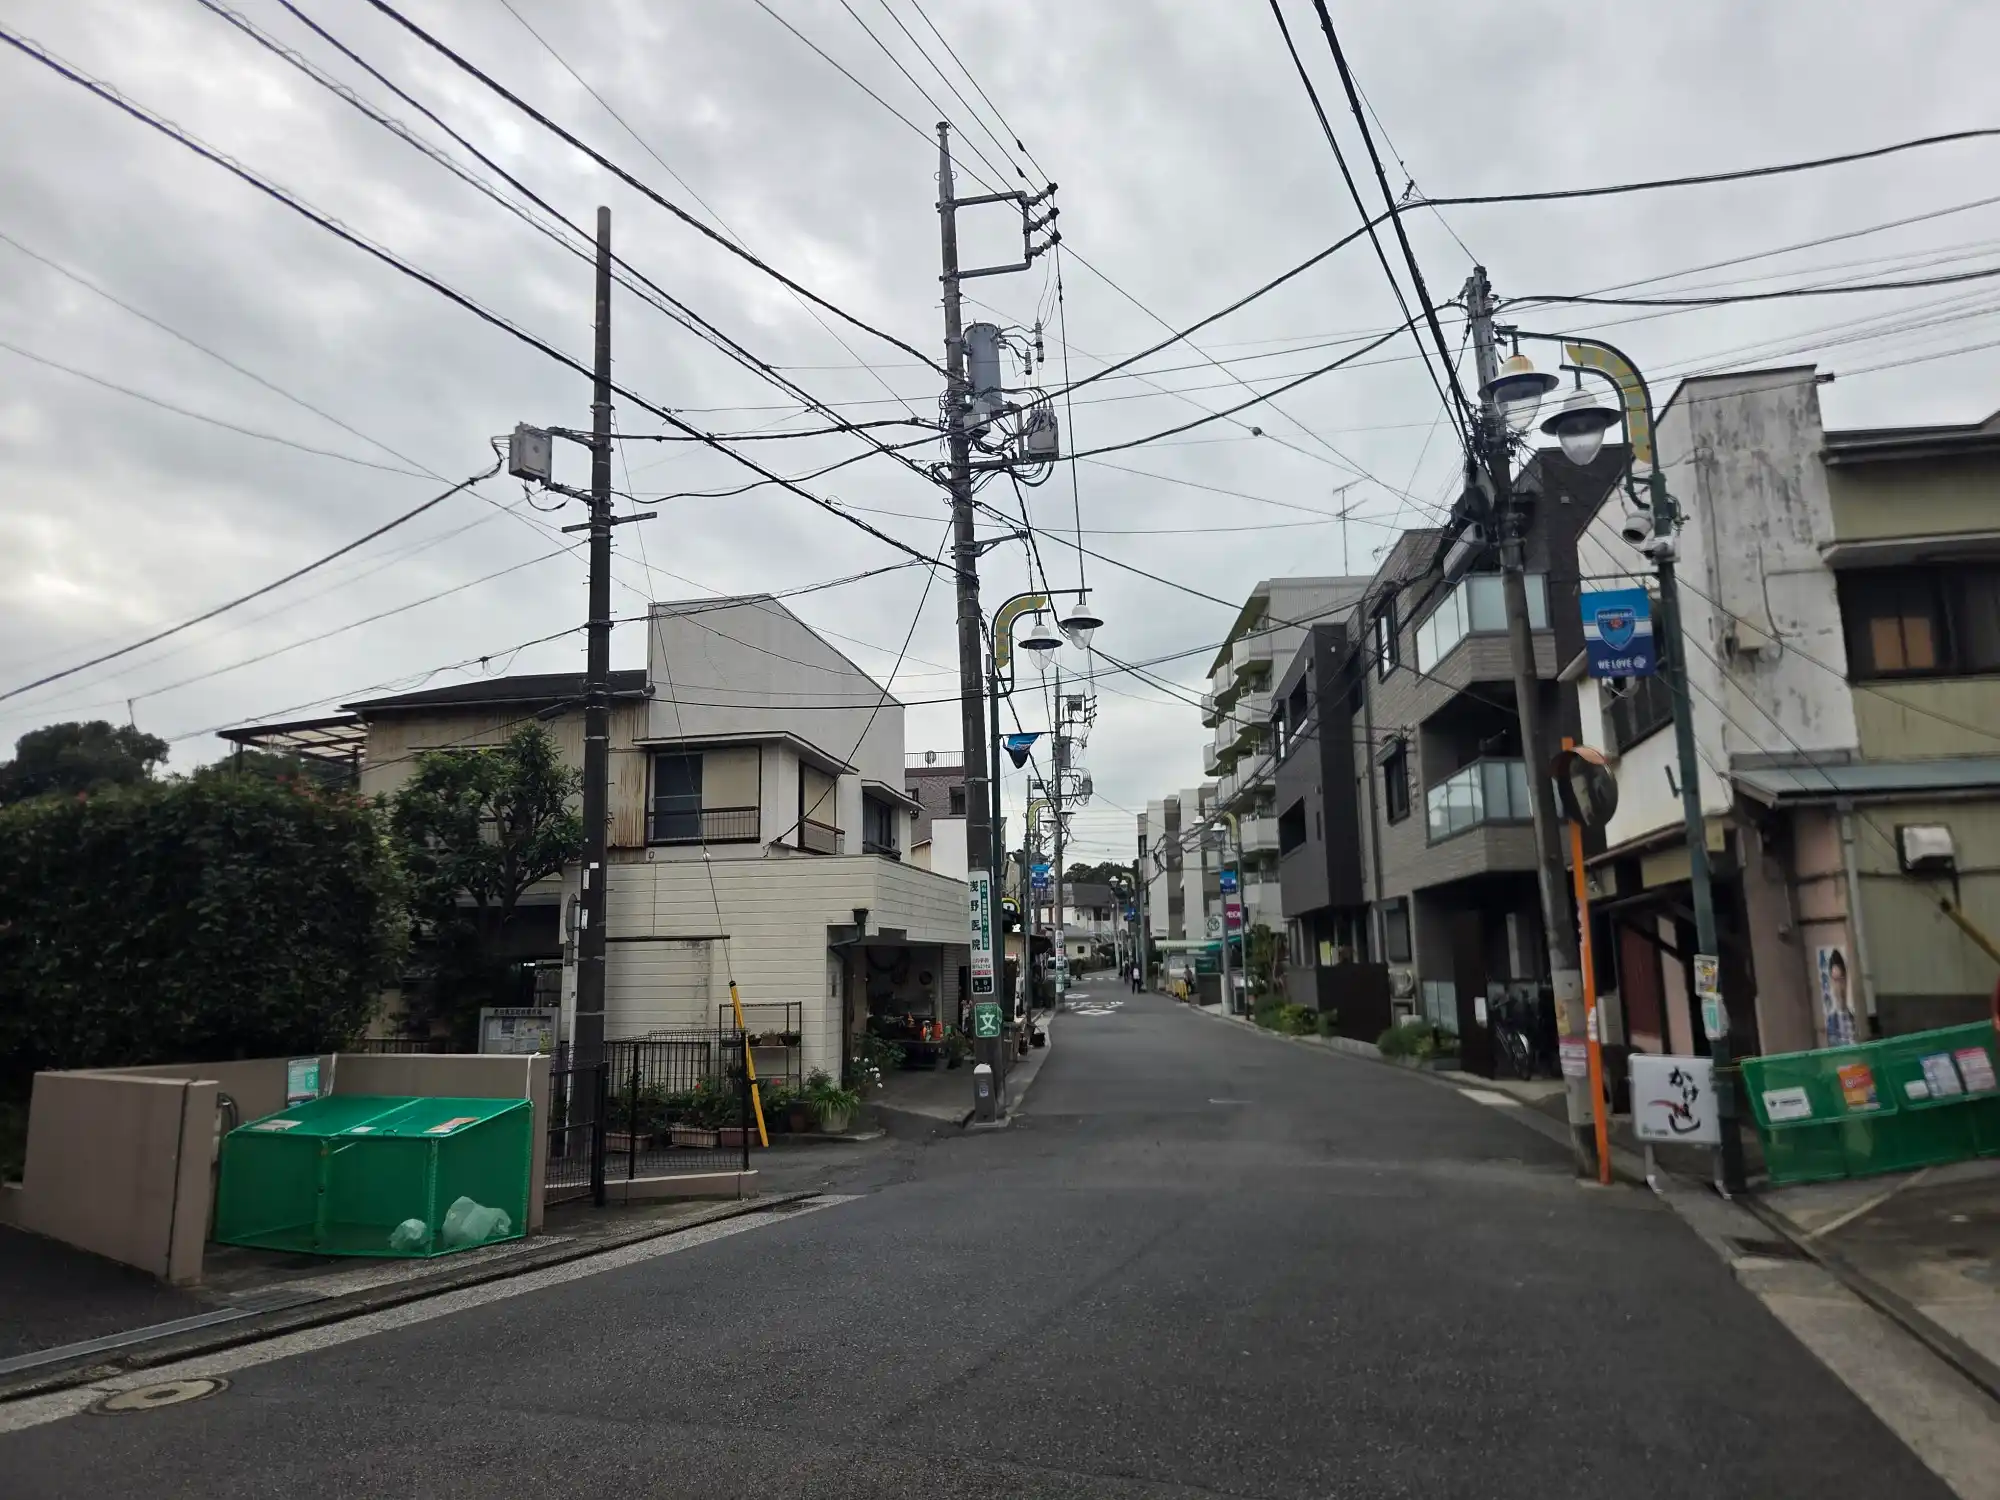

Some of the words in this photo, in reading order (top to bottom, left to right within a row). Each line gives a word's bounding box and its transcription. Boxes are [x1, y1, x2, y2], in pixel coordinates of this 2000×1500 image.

[1598, 661, 1610, 669] WE
[1611, 658, 1632, 668] LOVE
[970, 880, 981, 950] 浅野医院
[979, 1012, 996, 1031] 文
